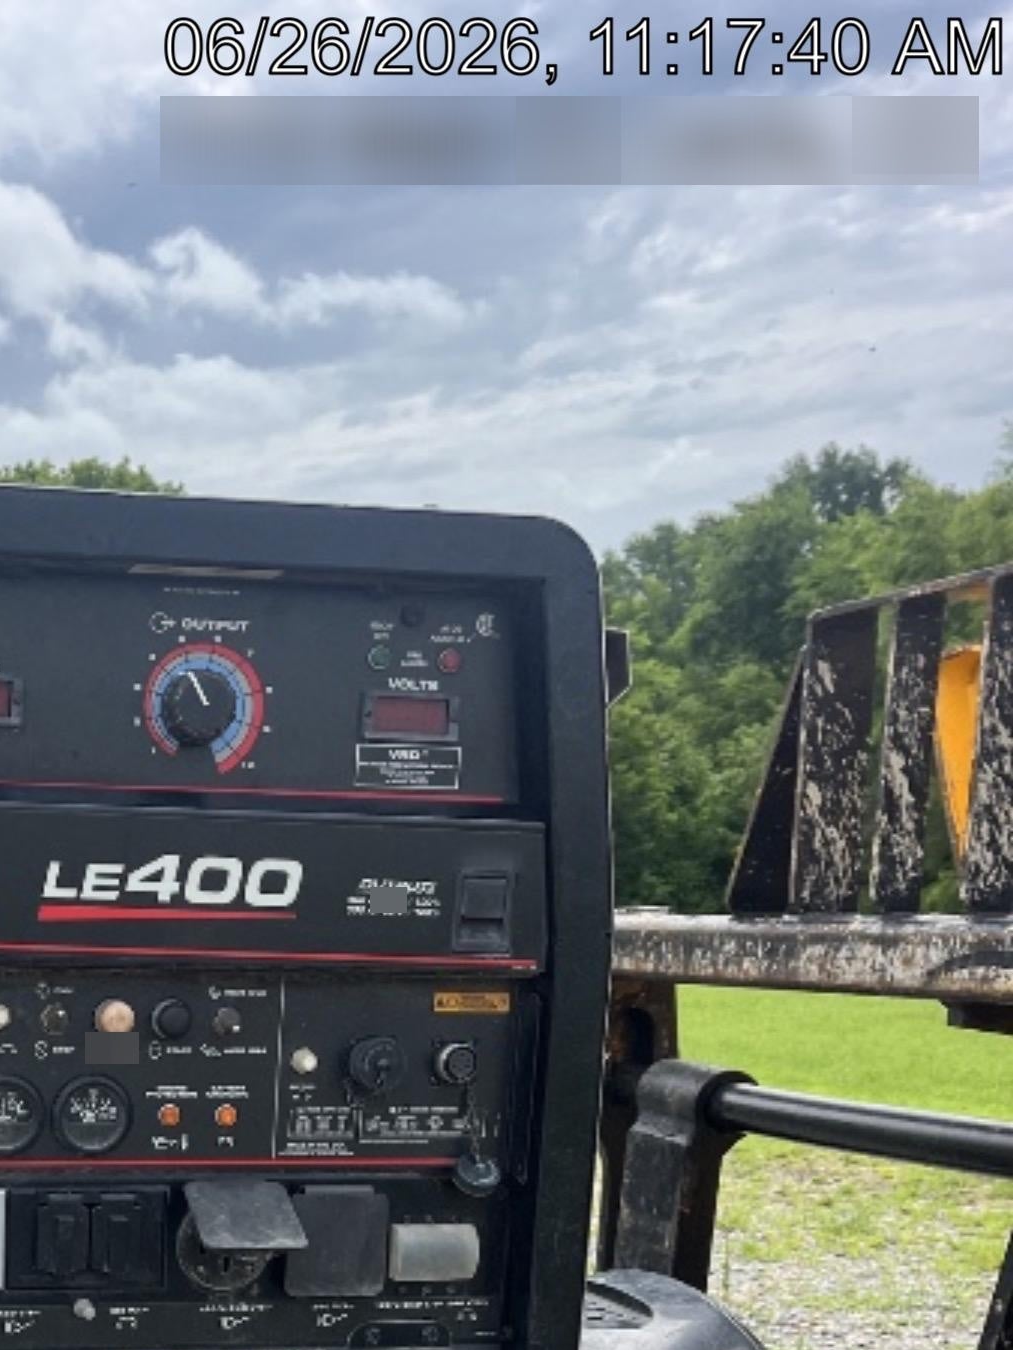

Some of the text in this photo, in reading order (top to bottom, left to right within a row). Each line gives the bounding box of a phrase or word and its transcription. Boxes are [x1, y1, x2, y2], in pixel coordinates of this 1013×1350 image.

[181, 617, 250, 632] OUTPUT
[388, 677, 439, 692] VOLTS
[41, 854, 304, 908] LE400
